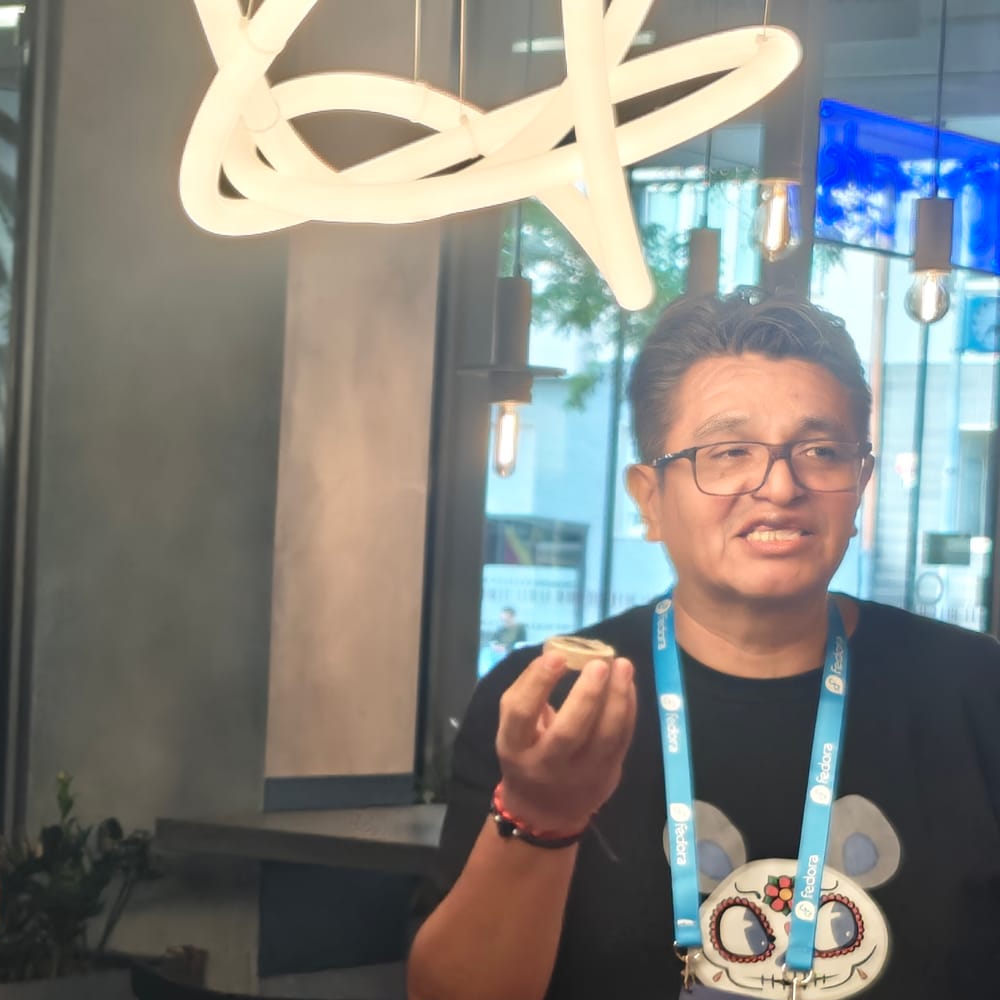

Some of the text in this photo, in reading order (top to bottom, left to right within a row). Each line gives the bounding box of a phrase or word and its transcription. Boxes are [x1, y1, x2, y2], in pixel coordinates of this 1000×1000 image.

[665, 713, 679, 752] fedora
[816, 743, 834, 785] fedora
[675, 822, 689, 865] fedora
[802, 854, 819, 900] fedora
